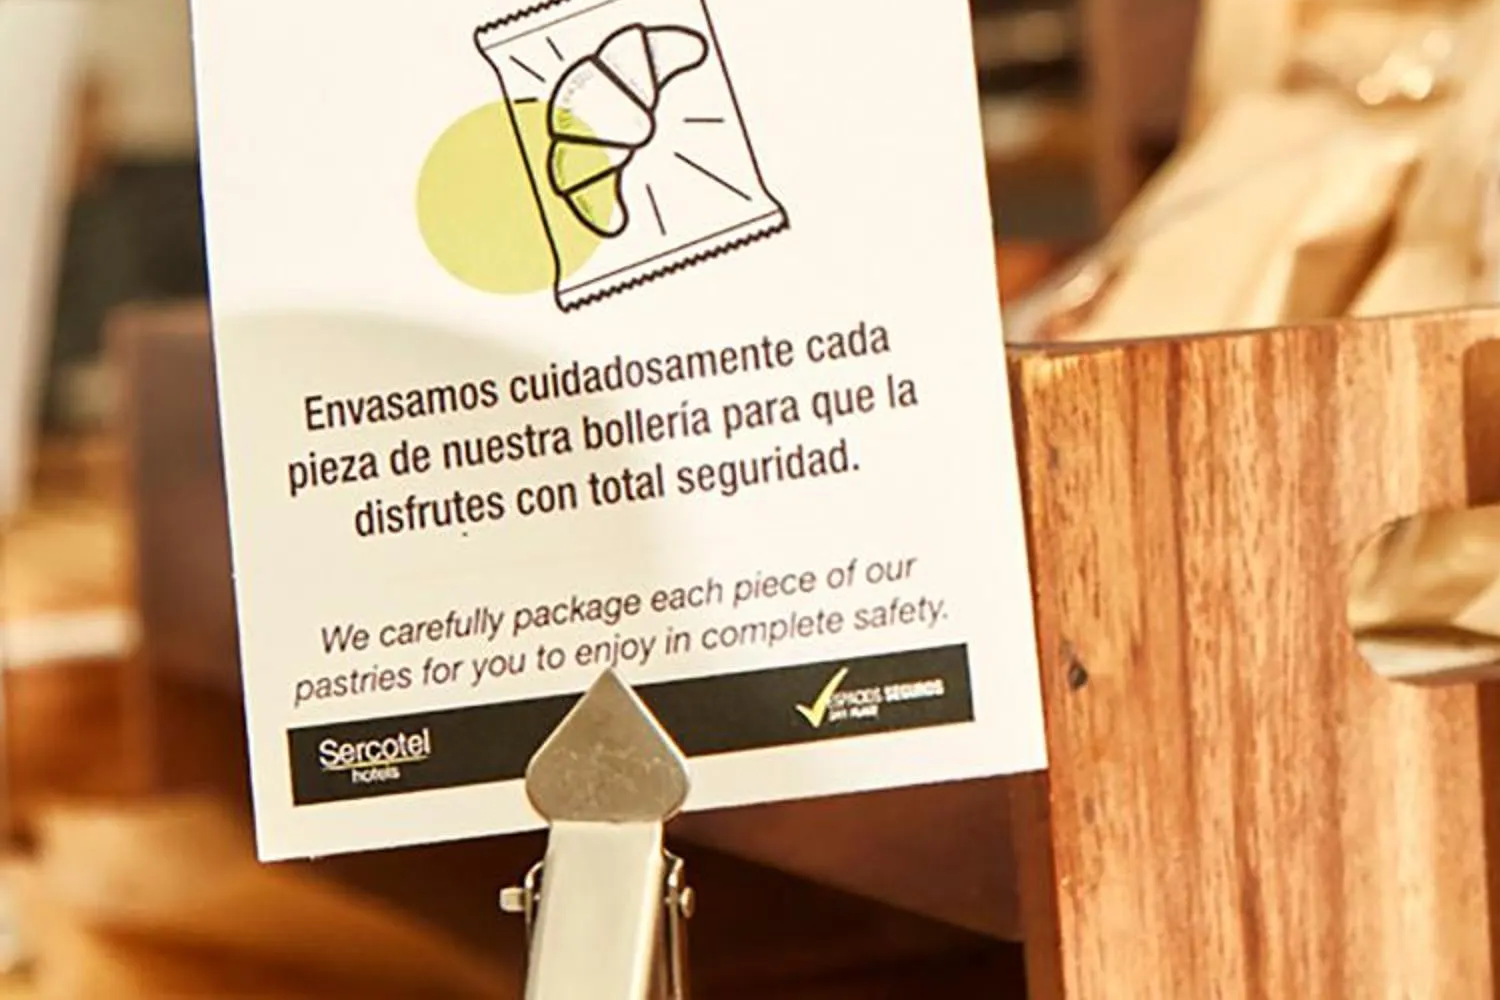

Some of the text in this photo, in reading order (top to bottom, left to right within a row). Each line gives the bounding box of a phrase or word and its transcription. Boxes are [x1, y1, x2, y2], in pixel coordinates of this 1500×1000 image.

[304, 320, 891, 432] Envasamos cuidadosamente cada
[288, 373, 919, 498] pieza de nuestra bollería para que la
[355, 437, 860, 538] disfrutes con total seguridad.
[293, 596, 948, 708] pastries for you to enjoy in complete safety.
[321, 558, 917, 655] We carefully package each piece of our
[319, 727, 432, 768] Sercotel
[351, 765, 401, 783] hotels
